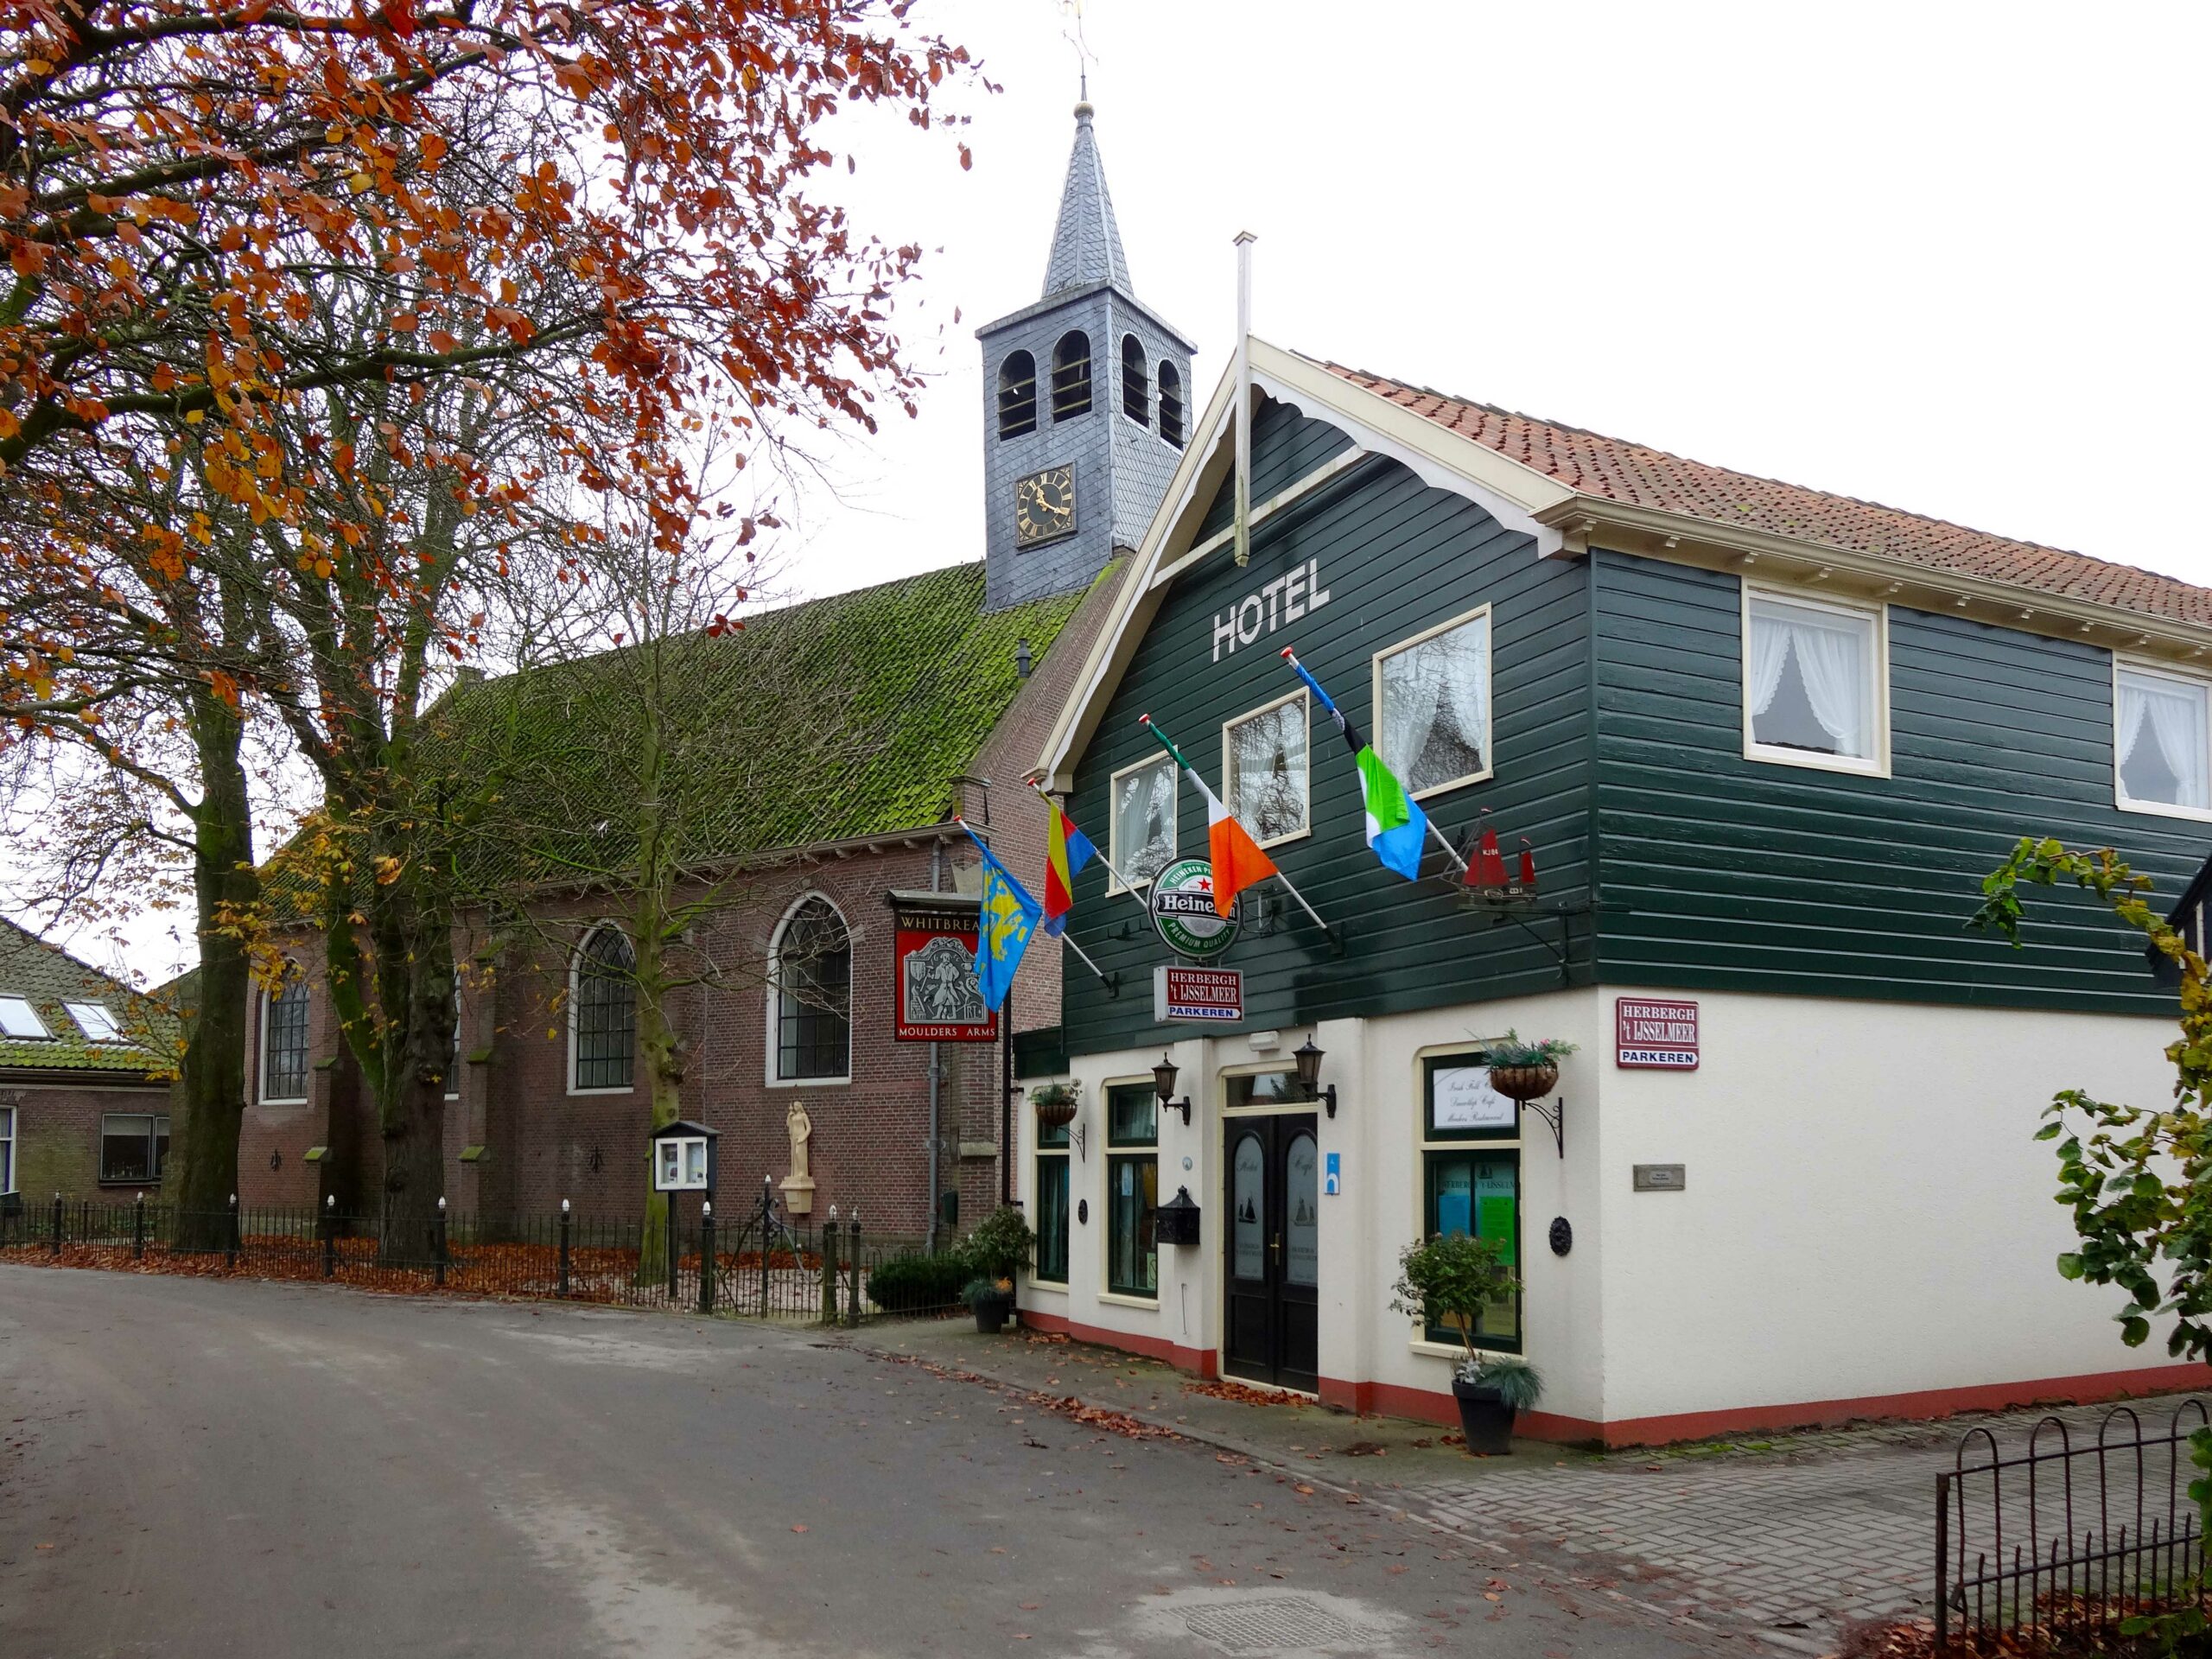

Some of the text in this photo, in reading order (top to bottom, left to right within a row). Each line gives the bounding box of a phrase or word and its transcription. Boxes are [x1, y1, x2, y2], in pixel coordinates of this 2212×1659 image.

[1213, 558, 1330, 663] HOTEL
[1169, 866, 1202, 884] HEINEKEN
[1164, 895, 1236, 918] Heinen
[901, 917, 980, 931] WHITBREA
[1168, 922, 1230, 948] PREMIUM QUALITY
[1171, 972, 1236, 985] HERBERGH
[1171, 984, 1236, 1002] 't IJSSELMEER
[1170, 1007, 1233, 1017] PARKEREN
[1623, 1005, 1695, 1020] HERBERGH
[899, 1027, 957, 1036] MOULDERS
[1623, 1020, 1695, 1043] 't IJSSELMEER
[1623, 1052, 1694, 1063] PARKEREN
